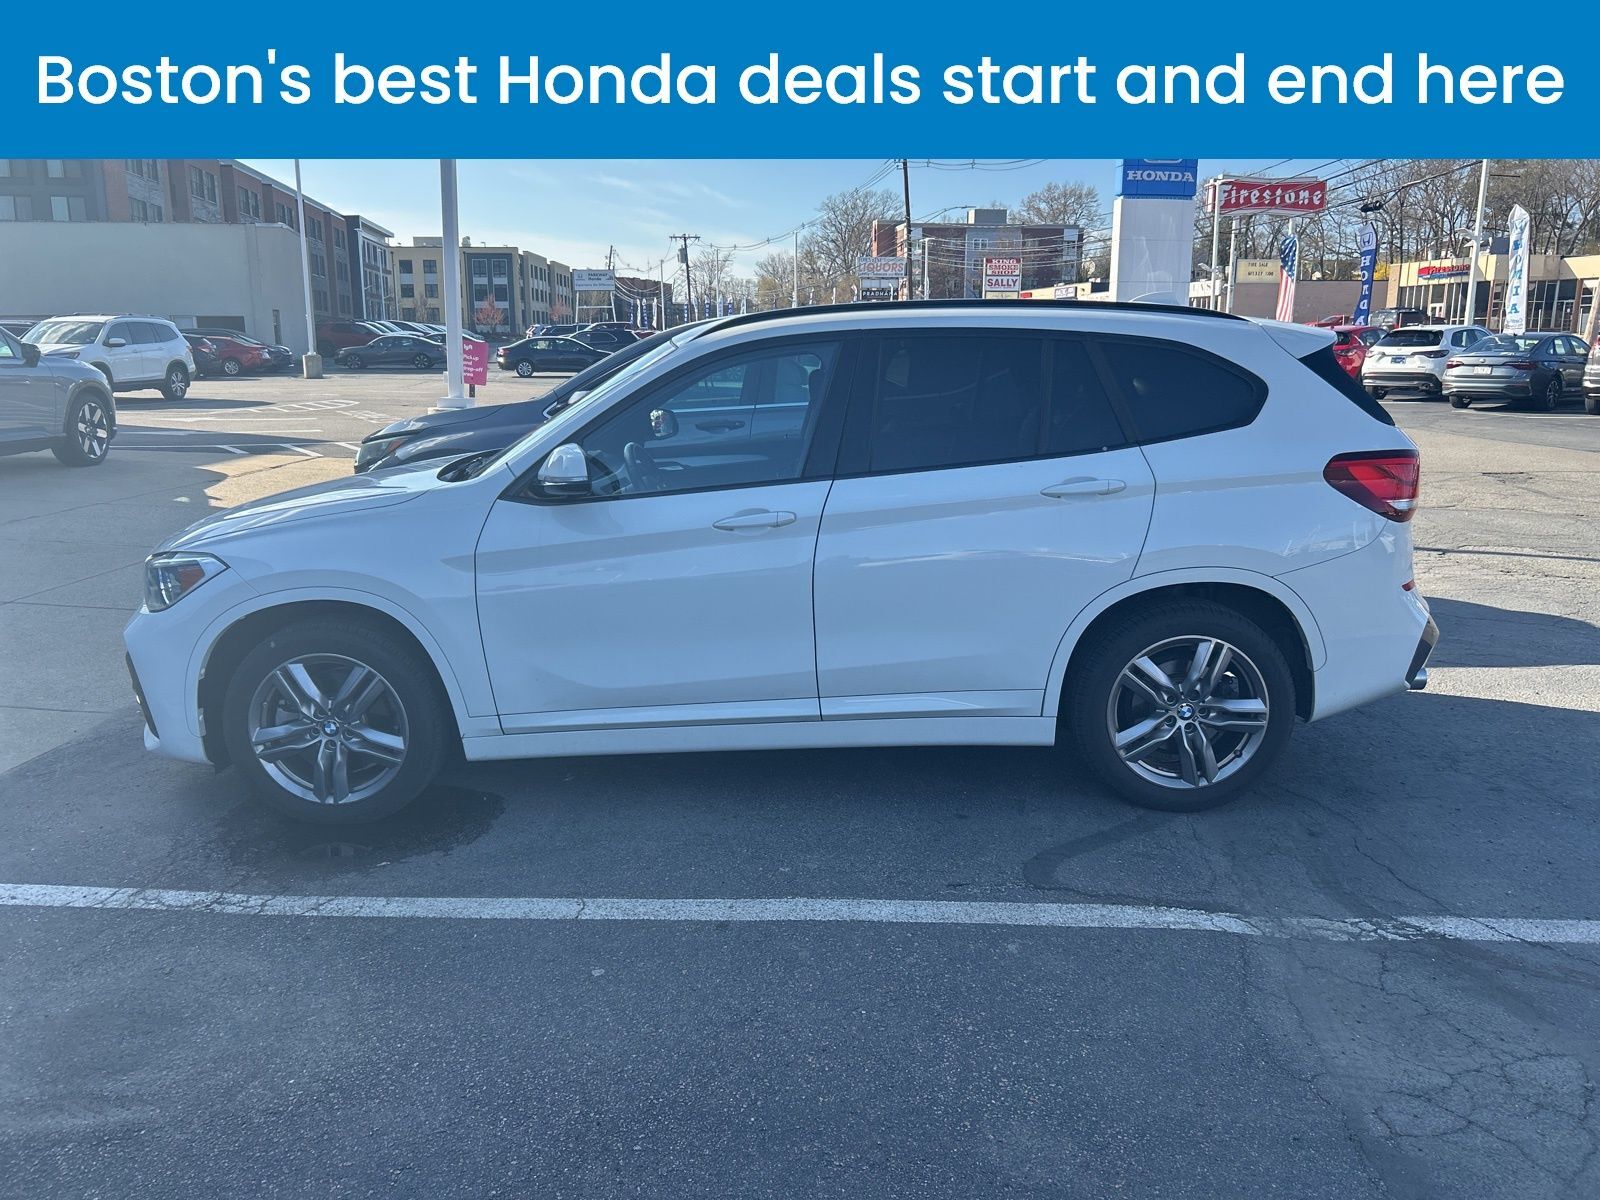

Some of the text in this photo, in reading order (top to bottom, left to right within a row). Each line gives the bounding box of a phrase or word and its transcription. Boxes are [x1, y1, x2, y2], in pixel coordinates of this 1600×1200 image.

[1126, 170, 1195, 182] HONDA
[1219, 184, 1323, 207] Firestone
[987, 278, 1018, 287] SALLY
